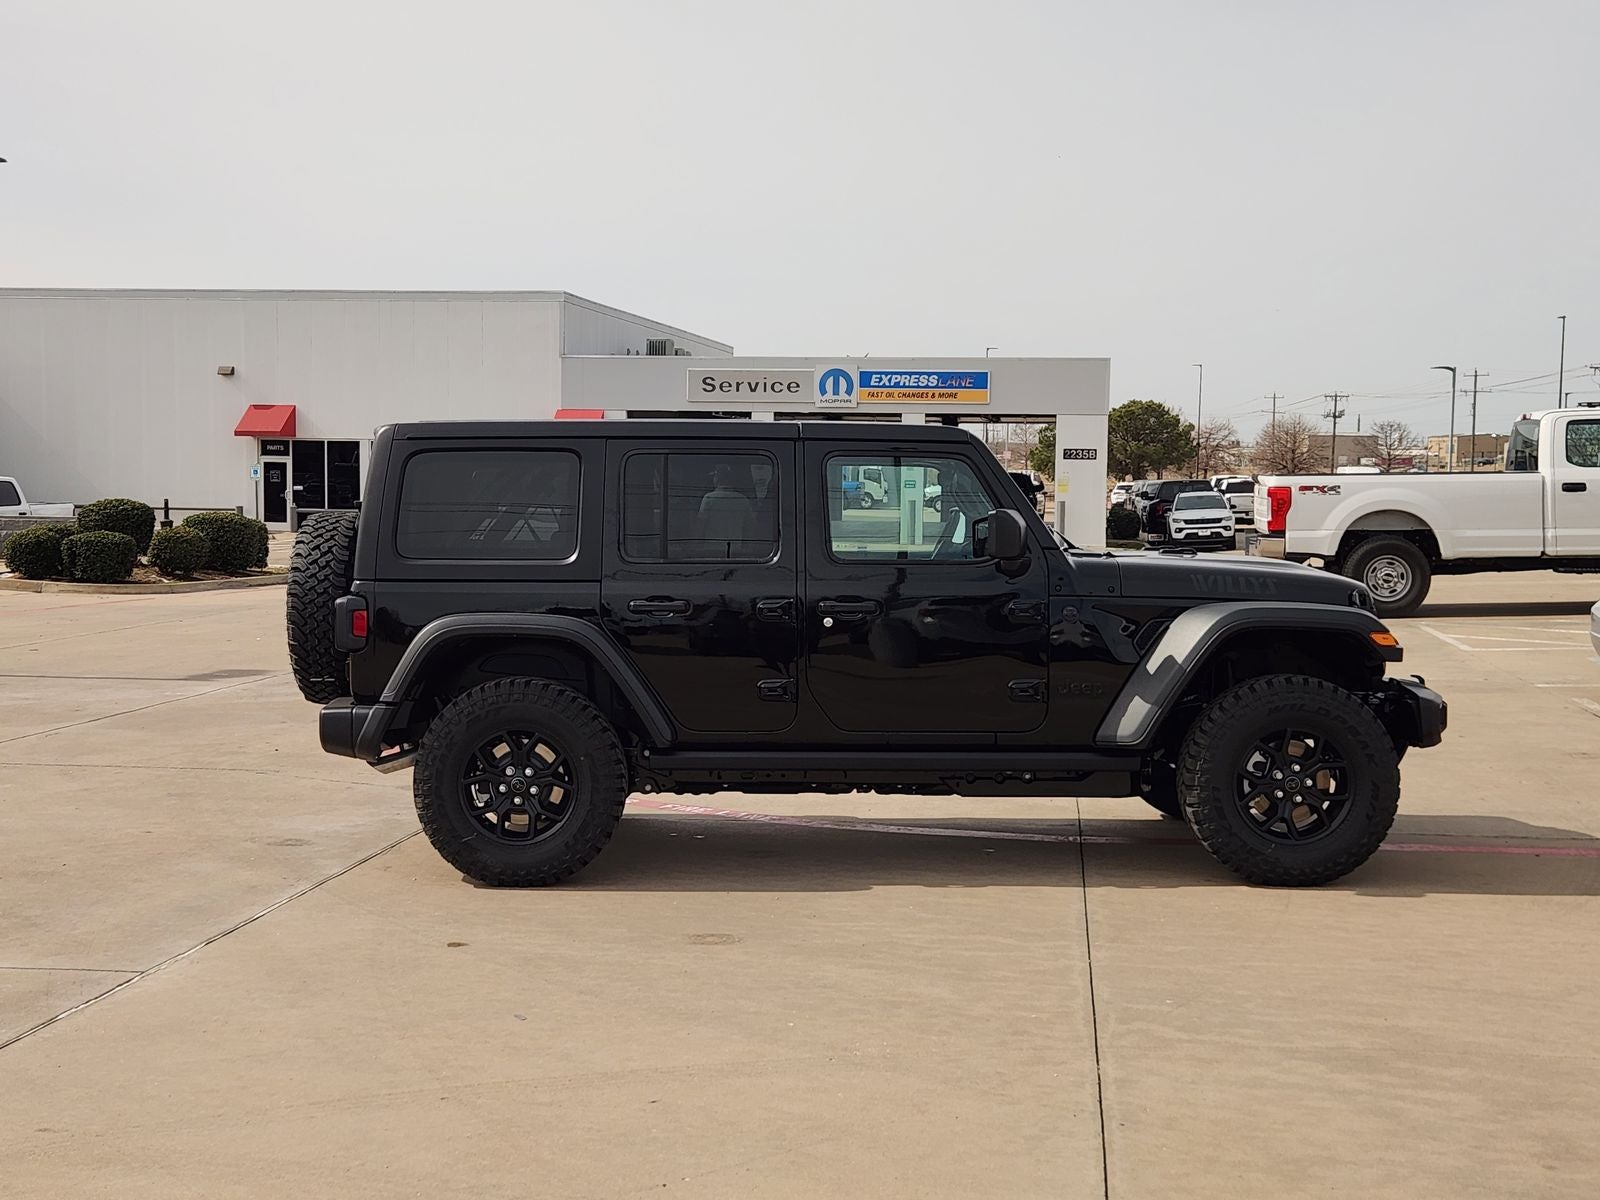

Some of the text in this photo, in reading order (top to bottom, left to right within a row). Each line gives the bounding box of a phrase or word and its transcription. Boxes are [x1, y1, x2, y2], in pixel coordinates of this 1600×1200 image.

[701, 376, 800, 393] Service
[867, 391, 884, 399] FAST
[885, 391, 896, 399] OIL
[897, 391, 929, 399] CHANGES
[1064, 449, 1096, 459] 2235B
[1189, 574, 1279, 595] WILLYS
